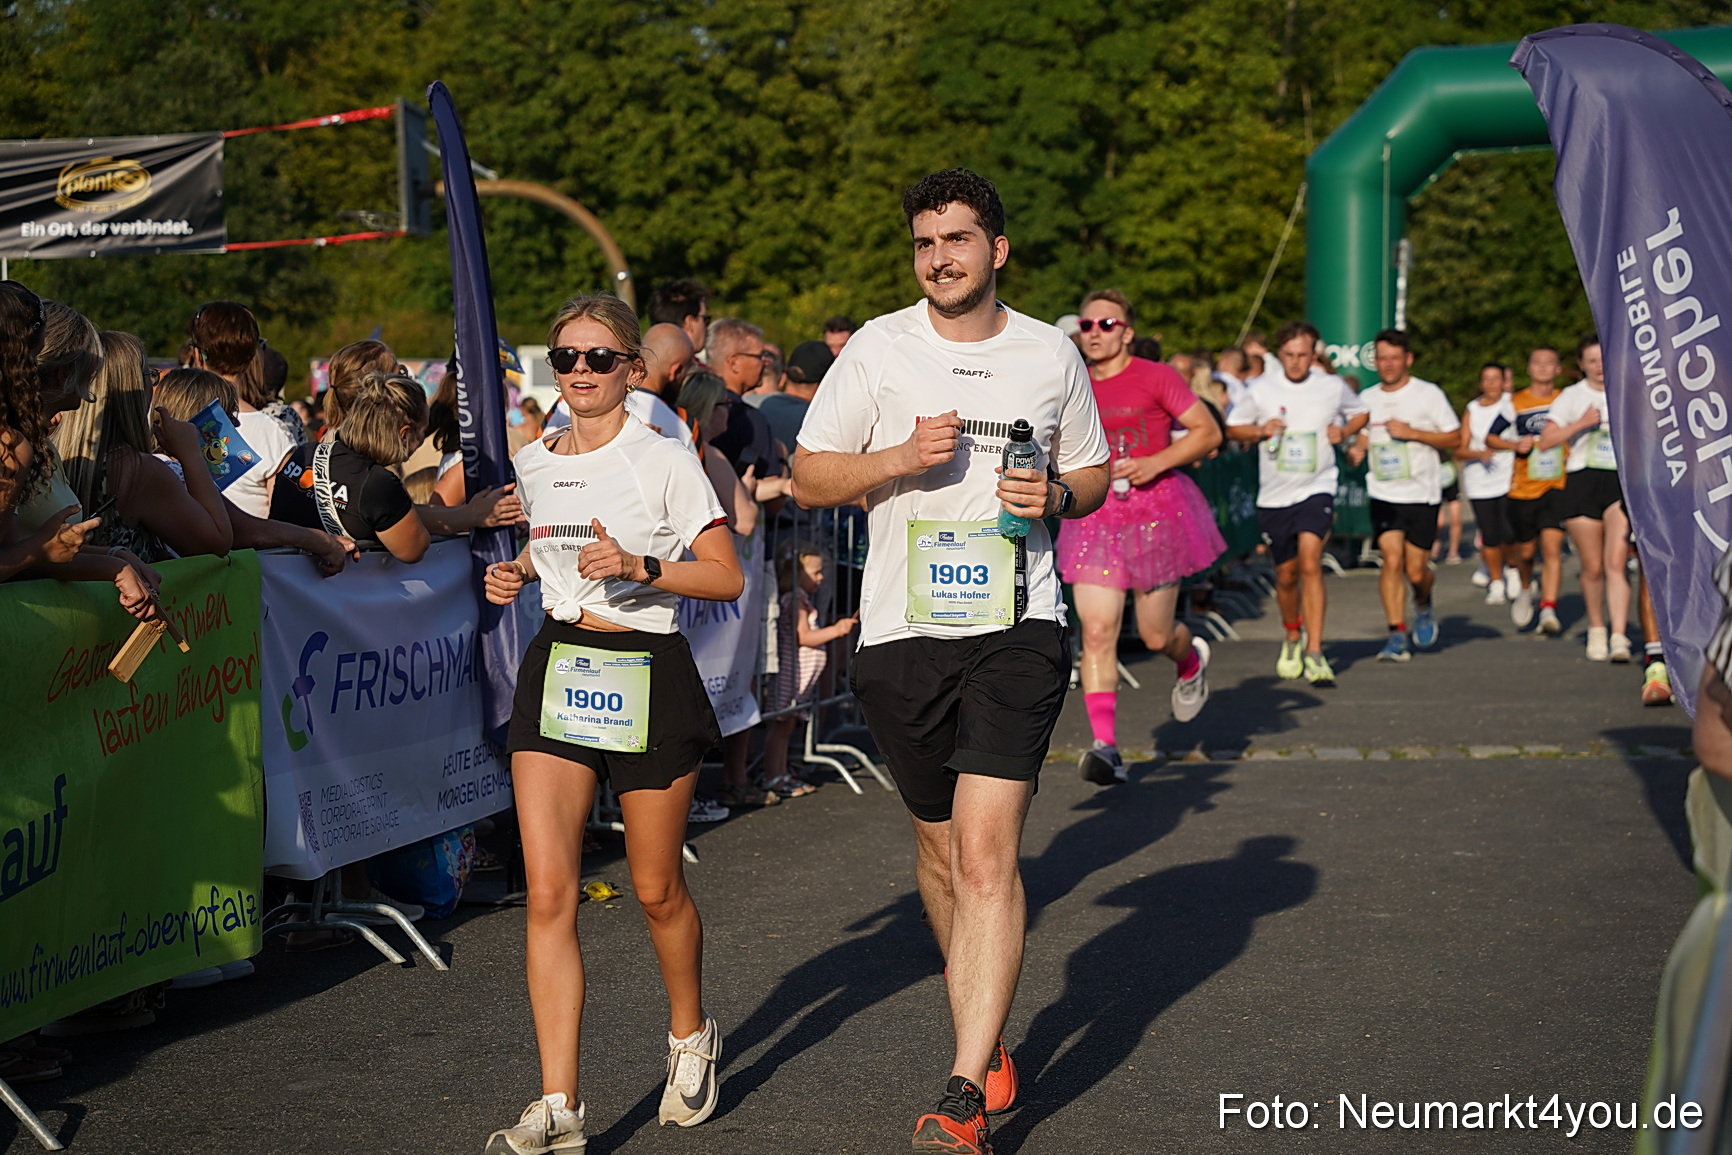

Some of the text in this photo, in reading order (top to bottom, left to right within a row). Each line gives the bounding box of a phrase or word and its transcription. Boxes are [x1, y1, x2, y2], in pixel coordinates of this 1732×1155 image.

[21, 219, 193, 238] Ein Ort, der verbindet.
[1325, 344, 1361, 368] OK
[952, 367, 984, 378] CRAFT
[974, 443, 1002, 454] ENER
[561, 543, 583, 552] ENER
[934, 541, 967, 549] Firmenlauf
[929, 563, 989, 585] 1903
[931, 589, 991, 600] Lukas Hofner
[330, 629, 480, 715] FRISCHMA
[569, 666, 602, 674] Firmenlauf
[564, 687, 623, 712] 1900
[93, 679, 169, 757] laufen
[556, 712, 633, 727] Katharina Brandl
[442, 748, 471, 778] HEUTE
[437, 767, 513, 813] MORGEN GEMAC
